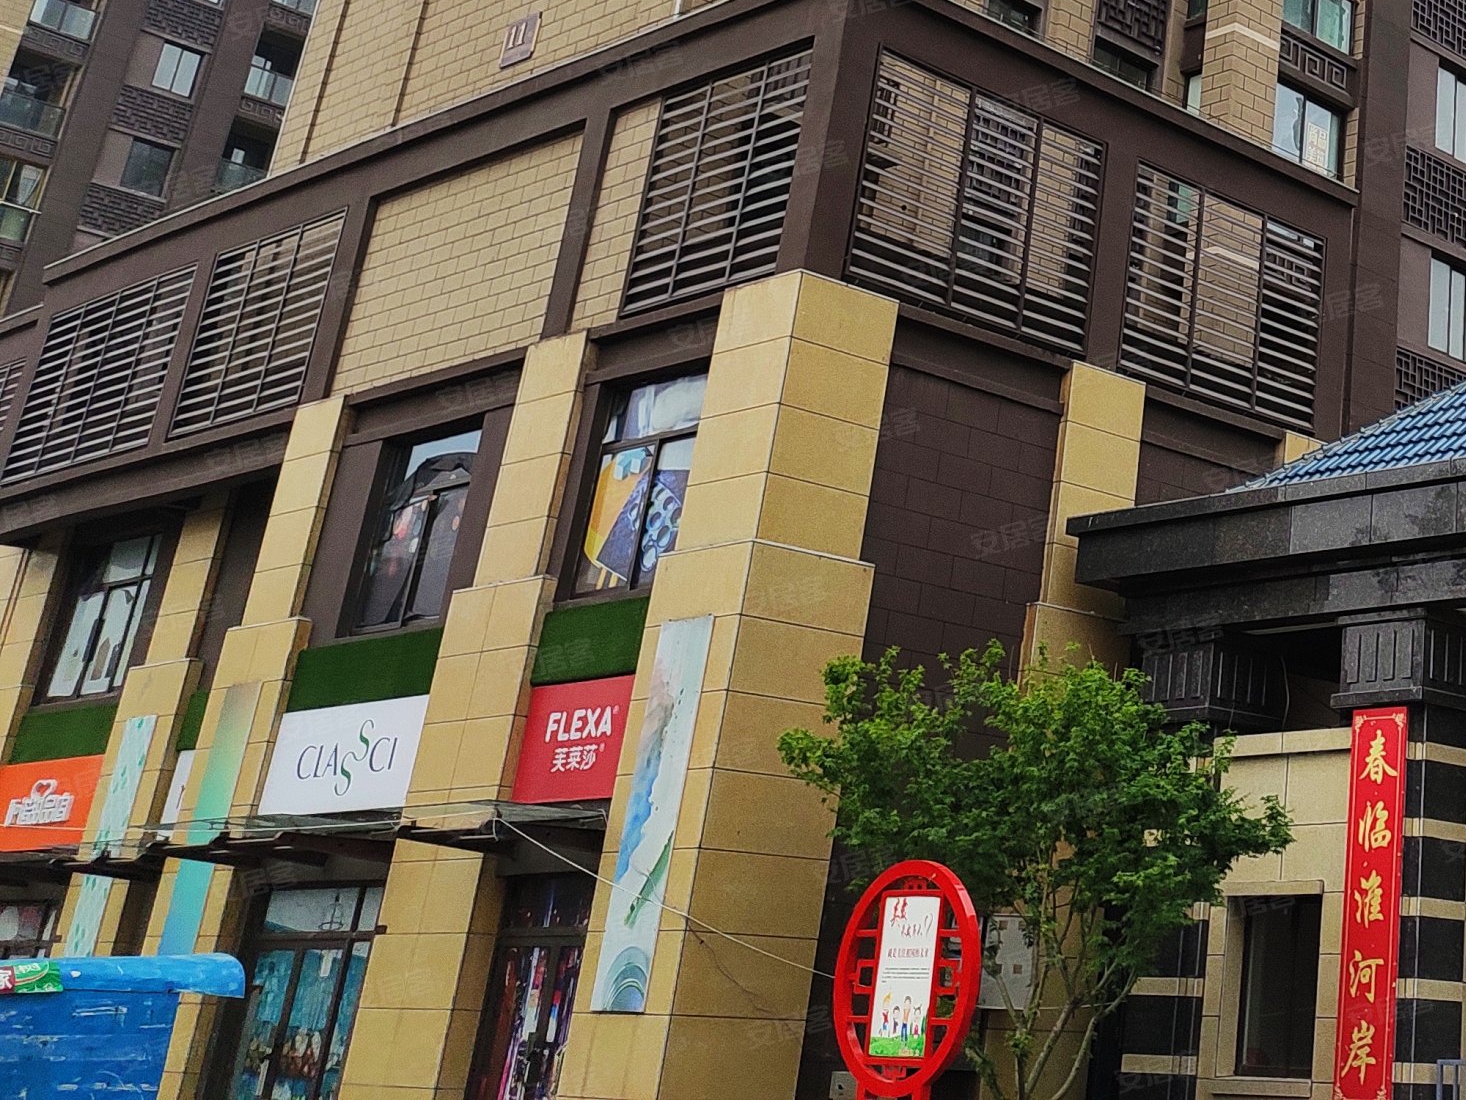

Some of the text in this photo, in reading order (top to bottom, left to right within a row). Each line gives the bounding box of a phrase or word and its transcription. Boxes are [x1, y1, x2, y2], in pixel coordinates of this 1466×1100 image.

[506, 22, 526, 50] 11
[545, 705, 612, 743] FLEXA
[550, 743, 598, 773] 芙莱莎
[1341, 729, 1398, 1086] 春临淮河岸
